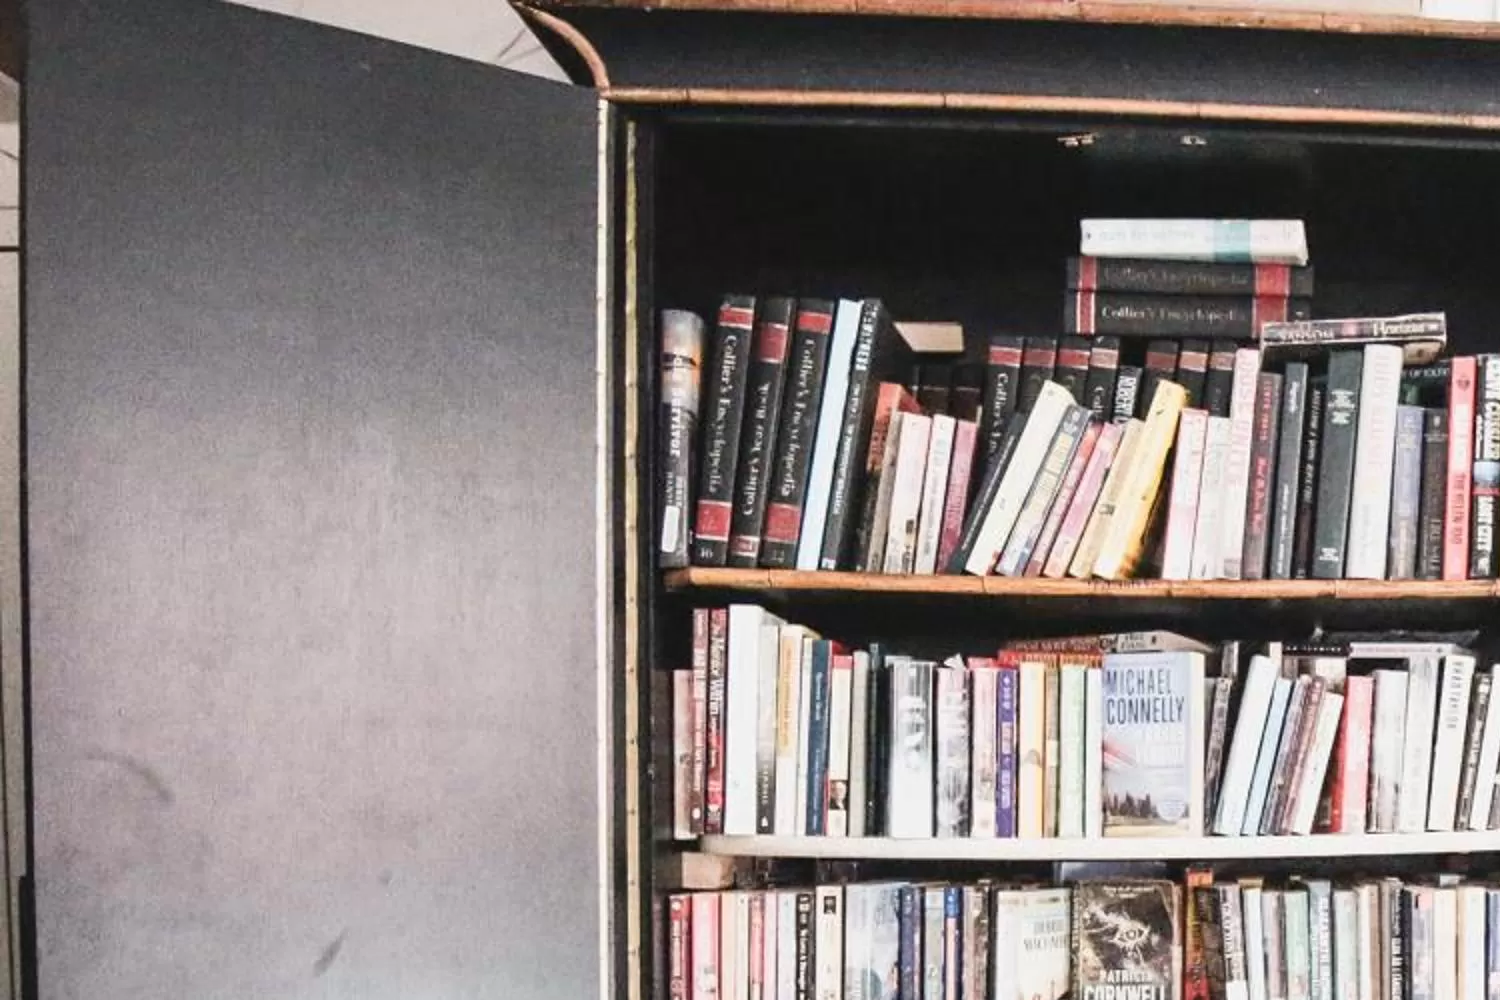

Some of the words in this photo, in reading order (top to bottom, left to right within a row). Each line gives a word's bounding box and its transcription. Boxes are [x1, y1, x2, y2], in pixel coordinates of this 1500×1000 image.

[718, 334, 737, 393] Collier's
[796, 338, 816, 397] Collier's
[665, 386, 686, 457] Survivor
[991, 371, 1009, 426] Collier's
[704, 397, 730, 494] Encyclopedia
[738, 457, 760, 515] Collier's
[1106, 669, 1171, 695] MICHAEL
[1107, 696, 1185, 725] CONNELLY
